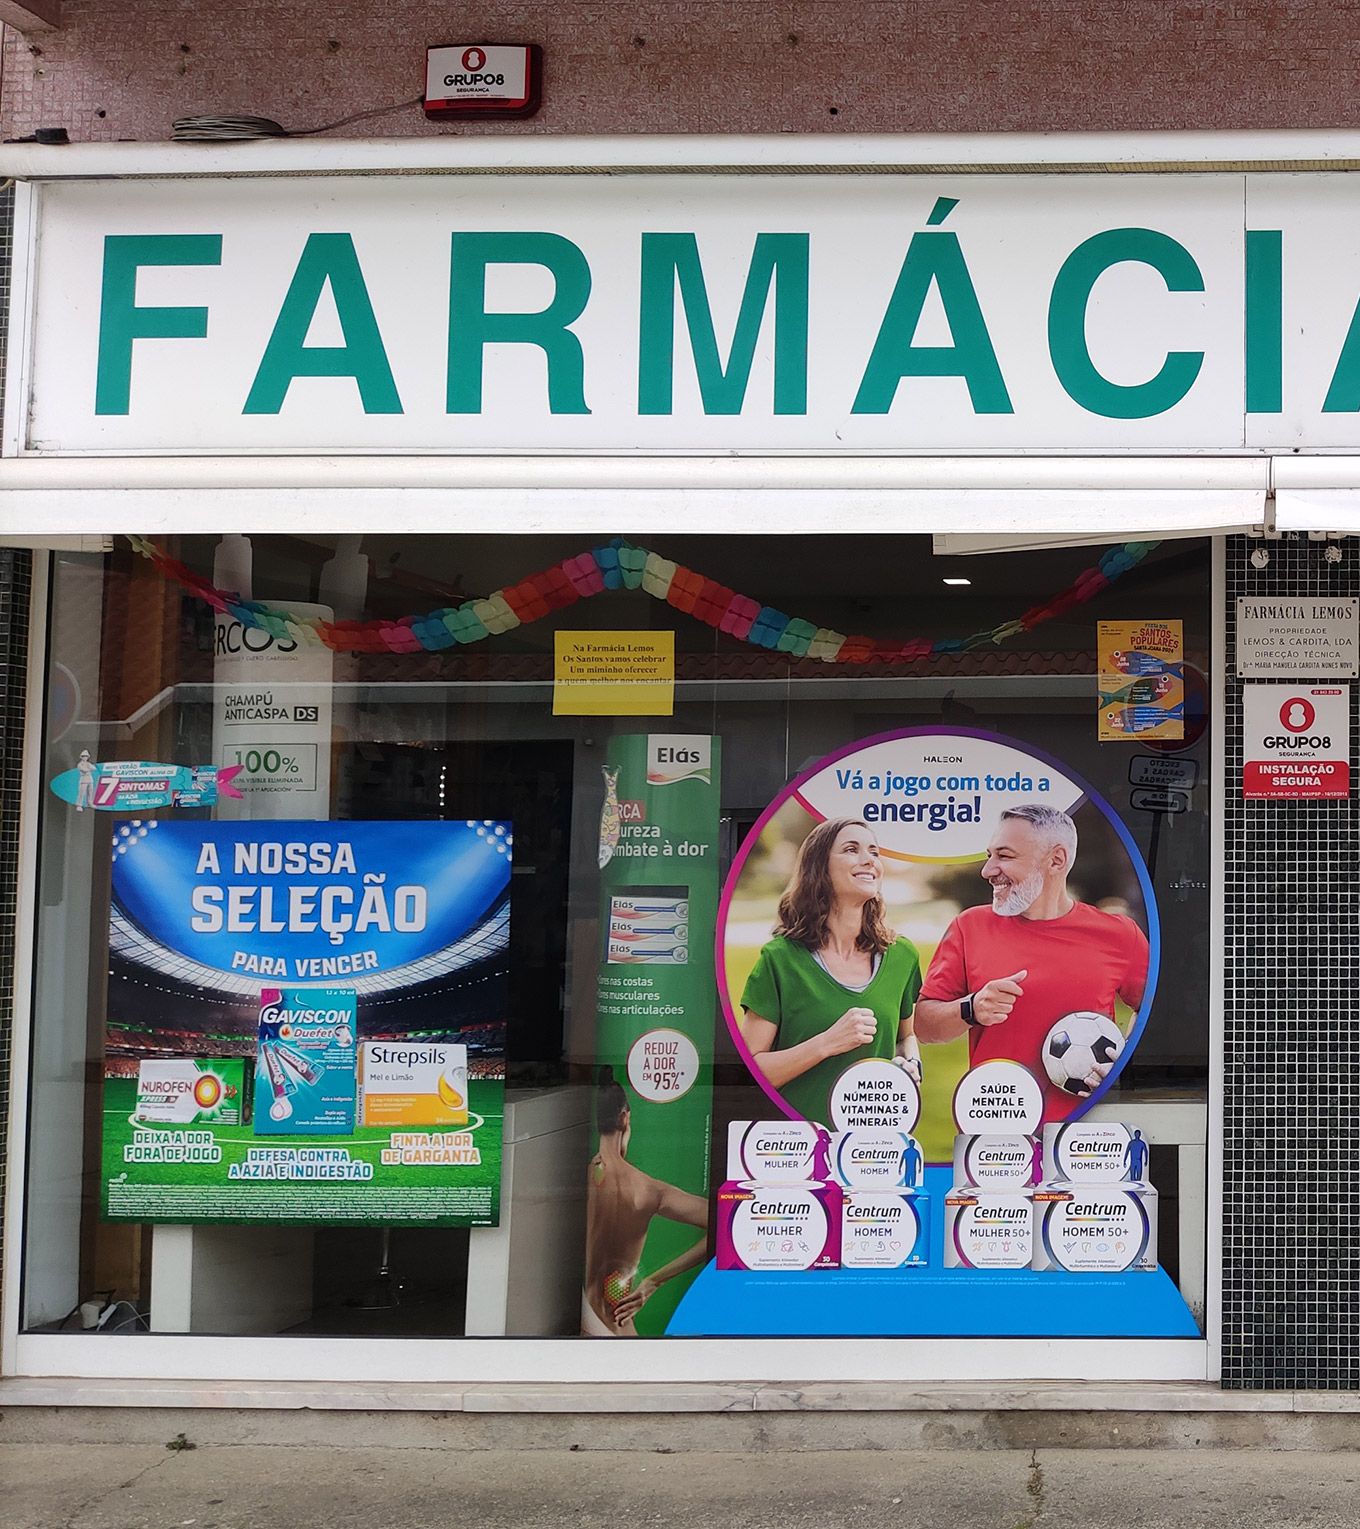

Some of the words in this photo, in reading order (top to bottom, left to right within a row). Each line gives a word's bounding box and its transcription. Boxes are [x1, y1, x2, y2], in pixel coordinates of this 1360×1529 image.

[443, 73, 505, 86] GRUPO8
[1244, 604, 1305, 619] FARMÁCIA
[1312, 606, 1352, 619] LEMOS
[1140, 628, 1172, 638] SANTOS
[587, 644, 625, 652] Farmácia
[1130, 636, 1179, 649] POPULARES
[1255, 651, 1299, 659] DIRECÇÃO
[225, 692, 273, 707] CHAMPÚ
[225, 708, 289, 720] ANTICASPA
[296, 709, 316, 720] DS
[1263, 736, 1331, 749] GRUPO8
[657, 747, 700, 763] Elás
[235, 750, 299, 774] 100%
[1259, 764, 1335, 776] INSTALAÇÃO
[118, 782, 166, 792] SINTOMAS
[836, 769, 863, 790] Vá
[869, 775, 881, 790] a
[884, 771, 931, 796] jogo
[937, 775, 980, 791] com
[985, 772, 1033, 791] toda
[1038, 777, 1050, 791] a
[1272, 777, 1321, 786] SEGURA
[98, 778, 120, 804] 7
[863, 796, 982, 831] energia!
[620, 825, 661, 838] ureza
[662, 839, 673, 856] à
[677, 840, 709, 856] dor
[195, 842, 221, 874] A
[234, 842, 357, 874] NOSSA
[190, 873, 429, 945] SELEÇÃO
[231, 951, 288, 977] PARA
[295, 950, 380, 977] VENCER
[623, 977, 653, 987] costas
[610, 990, 660, 1001] musculares
[262, 1007, 352, 1024] GAVISCON
[621, 1004, 685, 1017] articulações
[294, 1028, 333, 1038] Duefet
[644, 1042, 679, 1055] REDUZ
[280, 1049, 300, 1065] Duefet
[370, 1046, 447, 1068] Strepsils
[653, 1057, 676, 1070] DOR
[370, 1073, 383, 1081] Mel
[391, 1073, 414, 1081] Limão
[141, 1081, 193, 1093] NUROFEN
[857, 1080, 893, 1090] MAIOR
[980, 1083, 1016, 1094] SAÚDE
[843, 1091, 890, 1102] NÚMERO
[893, 1093, 907, 1102] DE
[972, 1097, 1014, 1106] MENTAL
[841, 1105, 899, 1114] VITAMINAS
[969, 1109, 1027, 1119] COGNITIVA
[135, 1132, 170, 1144] DEIXA
[187, 1133, 211, 1144] DOR
[393, 1135, 428, 1146] FINTA
[445, 1135, 471, 1146] DOR
[756, 1139, 809, 1151] Centrum
[1069, 1139, 1123, 1153] Centrum
[126, 1147, 161, 1159] FORA
[166, 1148, 181, 1159] DE
[186, 1147, 219, 1160] JOGO
[250, 1150, 295, 1161] DEFESA
[300, 1150, 349, 1161] CONTRA
[383, 1150, 399, 1162] DE
[404, 1150, 480, 1162] GARGANTA
[851, 1148, 899, 1160] Centrum
[978, 1150, 1026, 1161] Centrum
[242, 1165, 274, 1177] AZIA
[291, 1162, 371, 1178] INDIGESTÃO
[764, 1160, 799, 1168] MULHER
[1071, 1162, 1102, 1170] HOMEM
[1104, 1162, 1121, 1170] 50+
[978, 1169, 1009, 1177] MULHER
[750, 1200, 811, 1215] Centrum
[846, 1205, 901, 1218] Centrum
[974, 1206, 1028, 1218] Centrum
[1065, 1202, 1127, 1216] Centrum
[757, 1226, 803, 1236] MULHER
[854, 1227, 892, 1237] HOMEM
[970, 1228, 1010, 1238] MULHER
[1012, 1228, 1031, 1238] 50+
[1062, 1227, 1105, 1237] HOMEM
[1107, 1227, 1129, 1237] 50+
